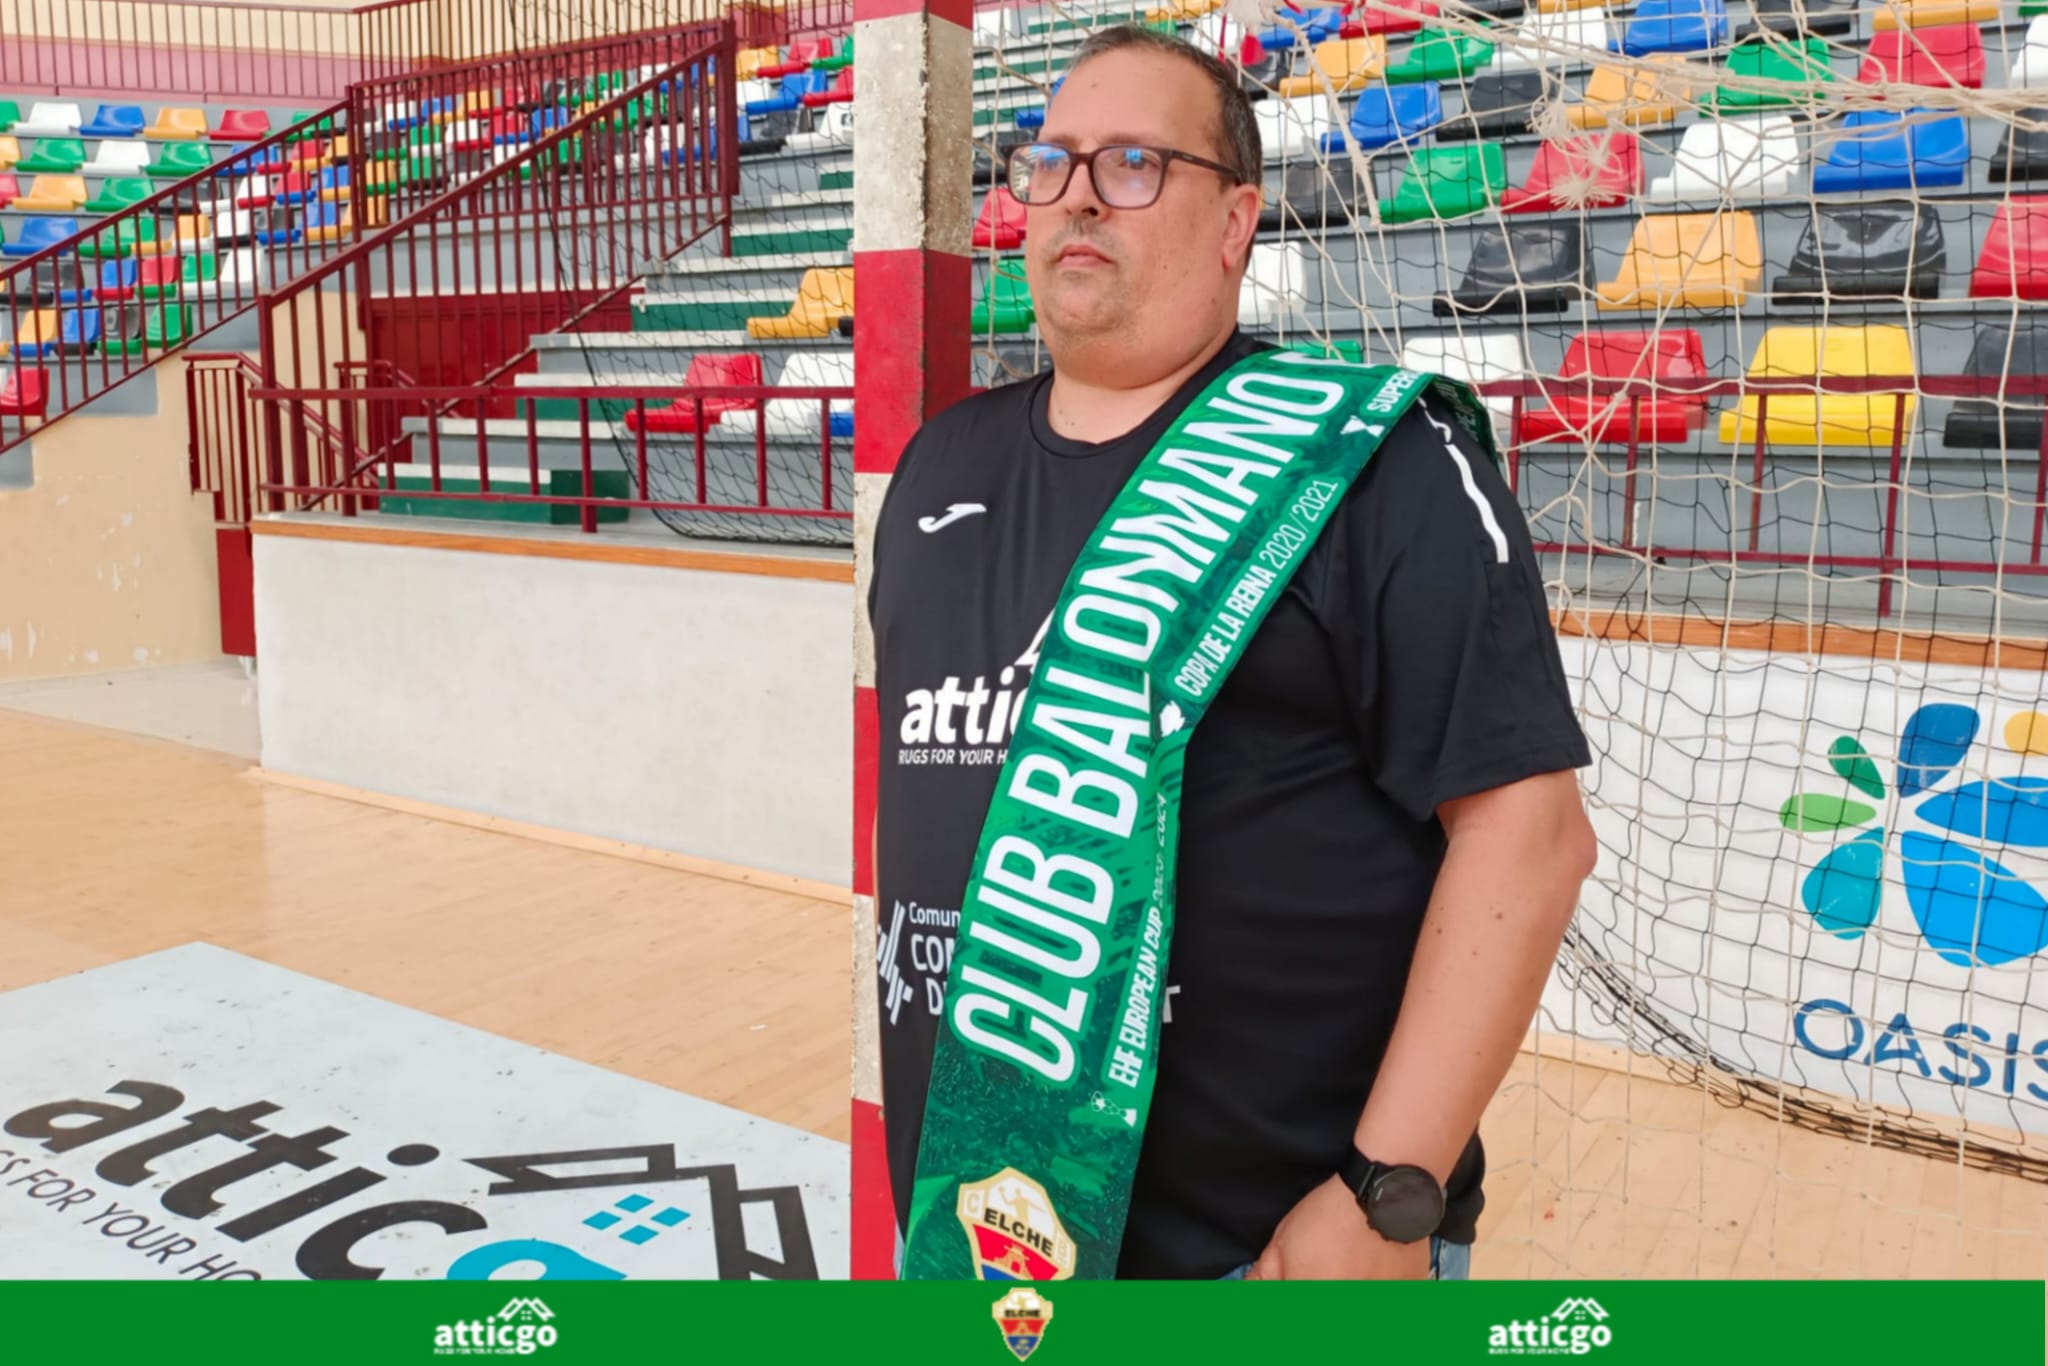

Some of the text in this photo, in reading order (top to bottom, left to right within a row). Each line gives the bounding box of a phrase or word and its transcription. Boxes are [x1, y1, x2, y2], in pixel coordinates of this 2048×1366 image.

[1008, 372, 1345, 839] BALONMANO
[1174, 479, 1339, 697] COPA DE LA REINA 2020/2021
[898, 749, 929, 765] RUGS
[930, 749, 956, 765] FOR
[958, 749, 994, 766] YOUR
[953, 835, 1115, 1083] CLUB
[1143, 906, 1163, 950] CUP
[1119, 946, 1158, 1051] EUROPEAN
[1108, 1045, 1143, 1089] EHF
[6, 1168, 97, 1213] FOR
[82, 1202, 197, 1264] YOUR
[983, 1207, 1054, 1257] ELCHE
